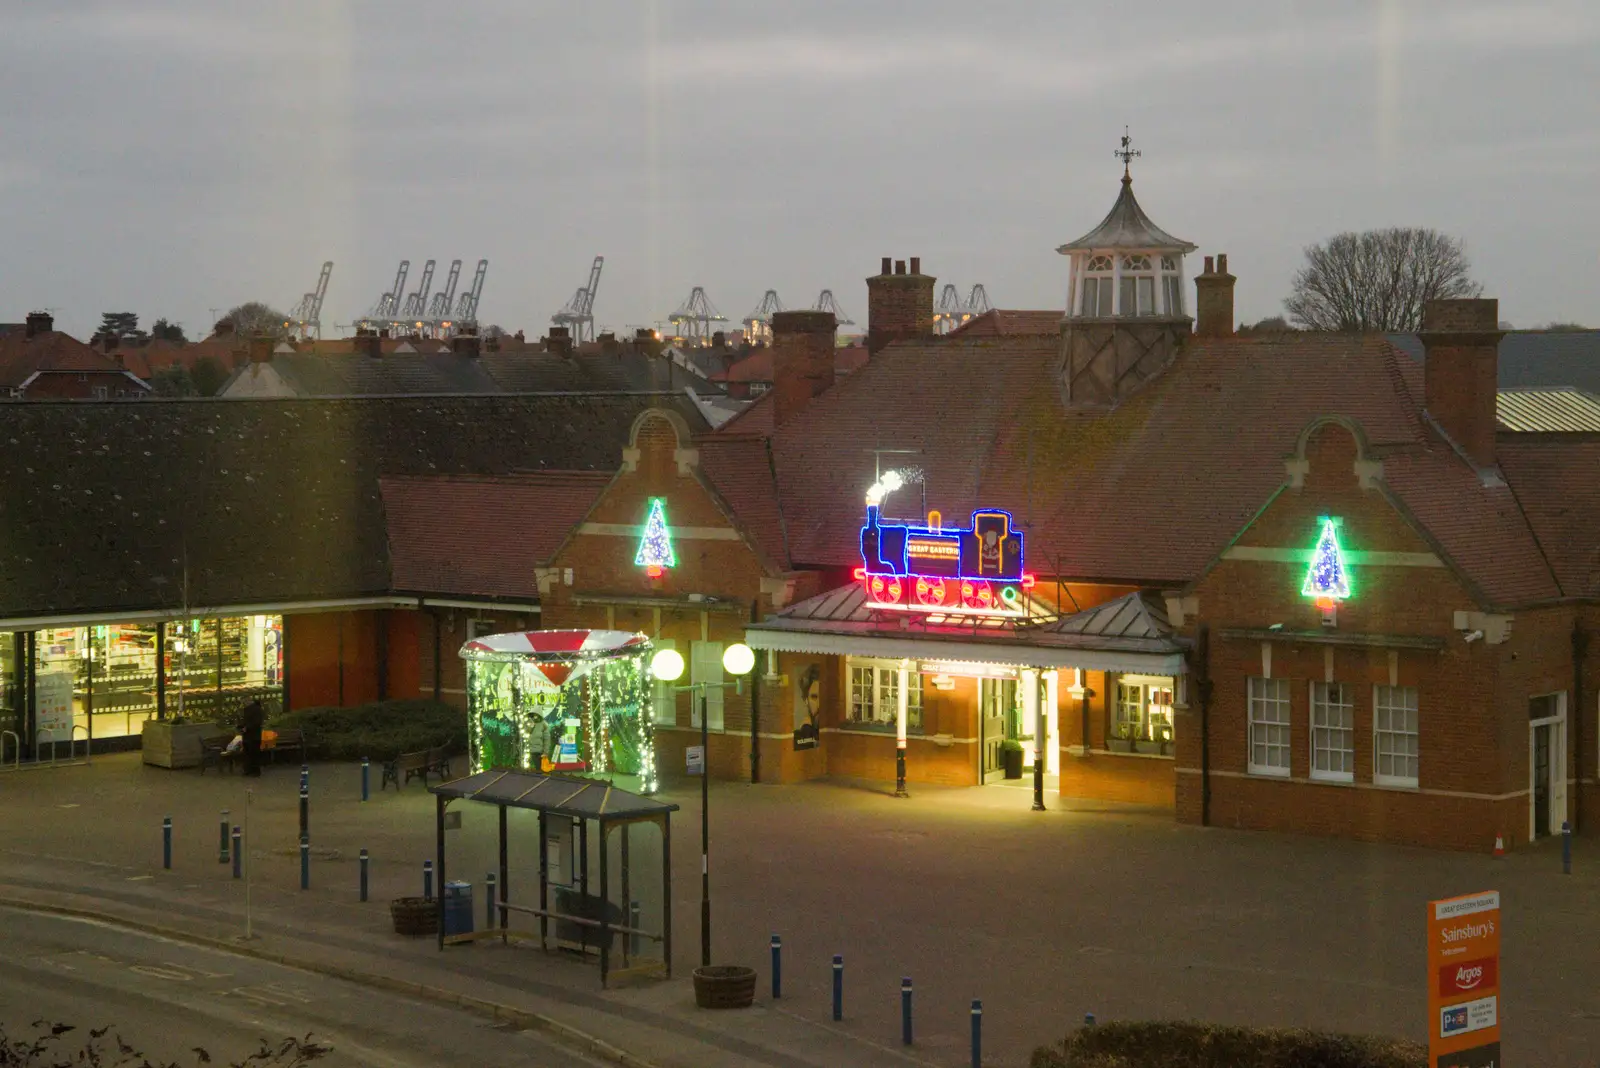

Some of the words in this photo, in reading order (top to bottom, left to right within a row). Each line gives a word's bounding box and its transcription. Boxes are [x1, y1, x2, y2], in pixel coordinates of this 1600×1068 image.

[908, 545, 929, 553] GREAT
[929, 546, 959, 555] EASTERN
[1441, 919, 1495, 944] Sainsbury's
[1455, 966, 1482, 983] Argos
